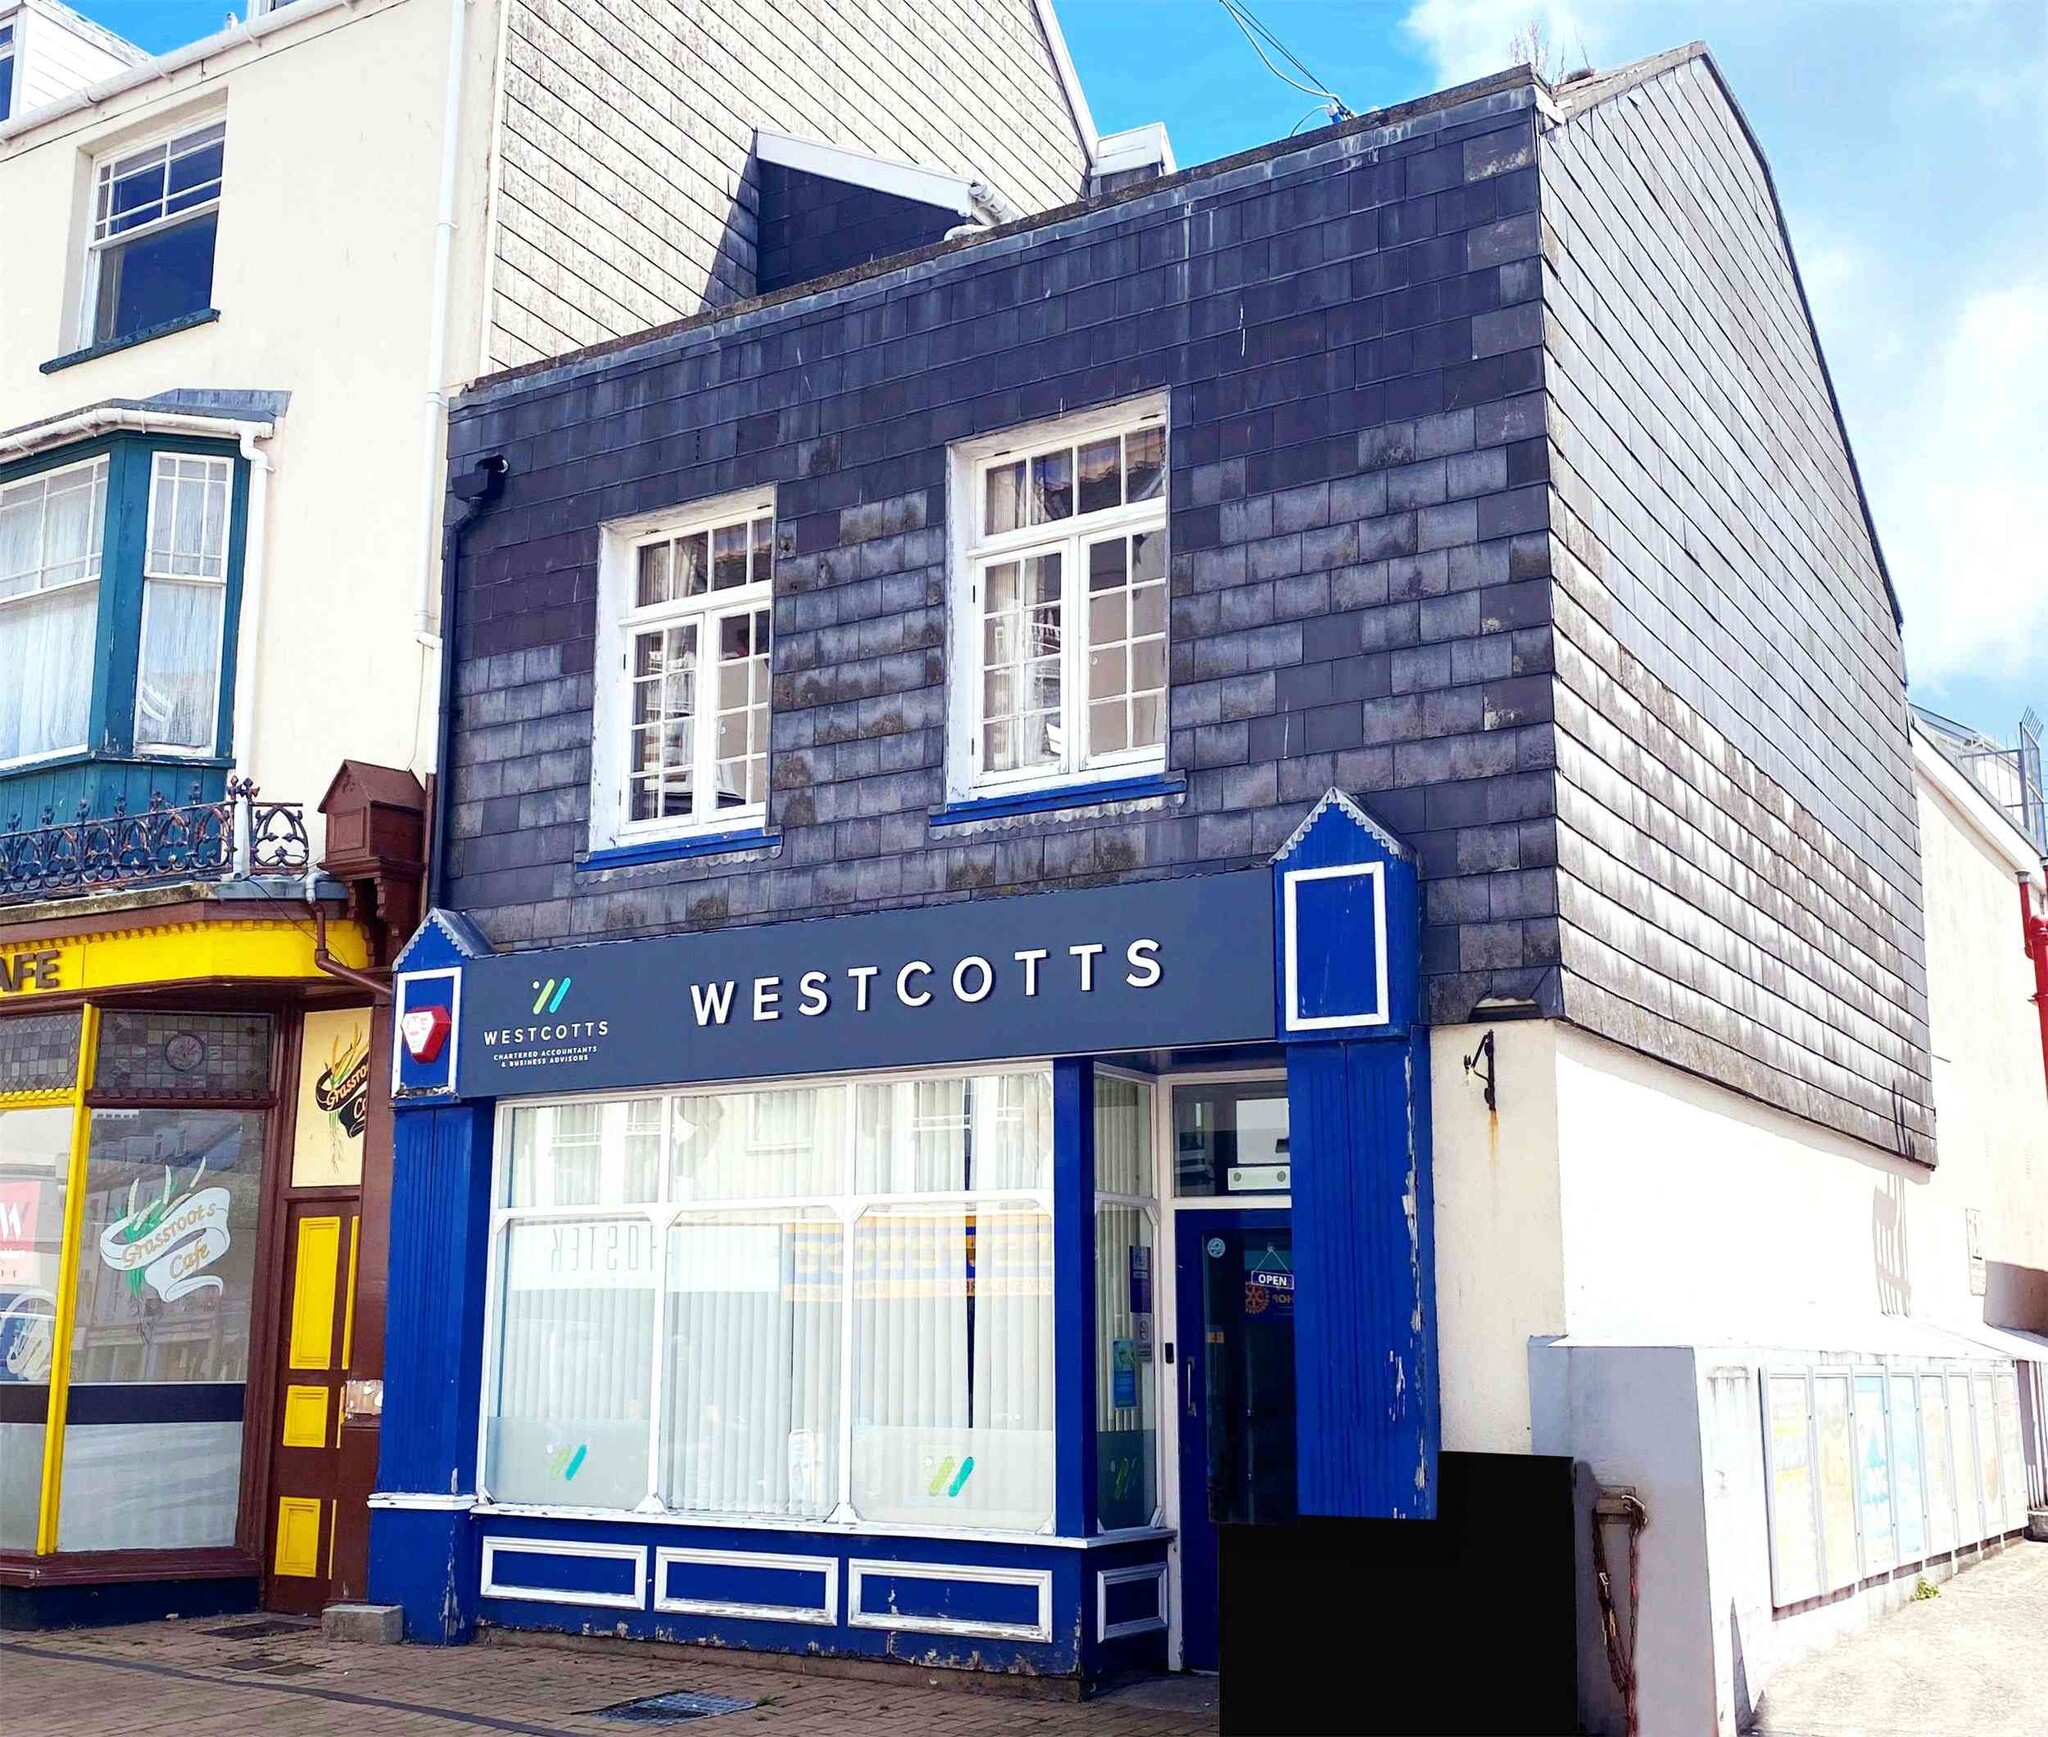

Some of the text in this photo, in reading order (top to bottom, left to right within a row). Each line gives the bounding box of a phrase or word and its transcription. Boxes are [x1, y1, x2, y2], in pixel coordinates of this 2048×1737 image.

[690, 938, 1163, 1027] WESTCOTTS
[483, 1021, 608, 1046] WESTCOTTS
[493, 1046, 598, 1061] CHARTERED ACCOUNTANTS
[509, 1058, 546, 1067] BUSINESS
[549, 1054, 589, 1064] ADVISORS
[326, 1063, 368, 1110] Grassro
[169, 1236, 210, 1279] Cafe
[1258, 1274, 1287, 1286] OPEN
